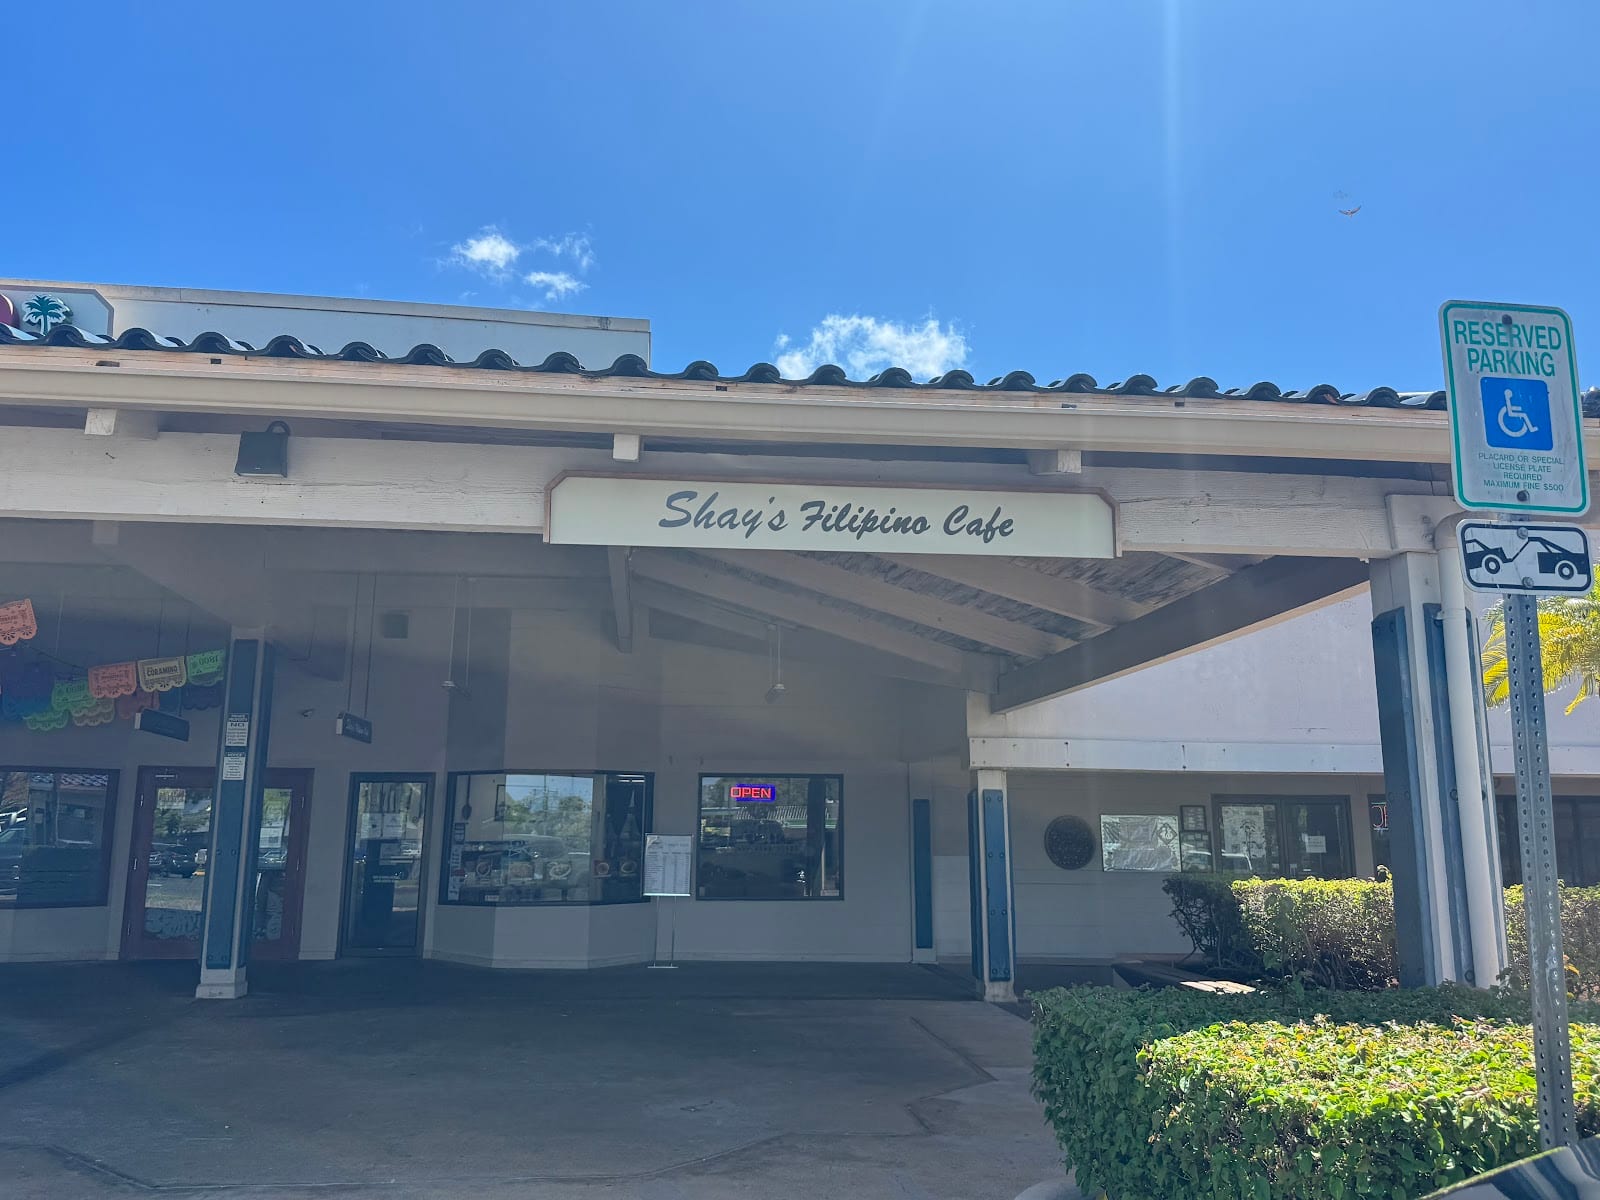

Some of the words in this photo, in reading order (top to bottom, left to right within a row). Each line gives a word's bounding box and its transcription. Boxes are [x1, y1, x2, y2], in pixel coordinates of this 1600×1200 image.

[1454, 320, 1561, 350] RESERVED
[1467, 348, 1555, 377] PARKING
[1478, 452, 1515, 461] PLACARD
[1517, 455, 1529, 463] OR
[1531, 456, 1564, 465] SPECIAL
[1493, 462, 1526, 471] LICENSE
[1528, 465, 1552, 473] PLATE
[1503, 472, 1542, 481] REQUIRED
[1483, 479, 1520, 489] MAXIMUM
[1523, 482, 1540, 490] FINE
[1543, 483, 1564, 491] $500
[658, 489, 789, 538] Shay's
[799, 500, 931, 539] Filipino
[942, 505, 1015, 544] Cafe
[730, 786, 771, 799] OPEN
